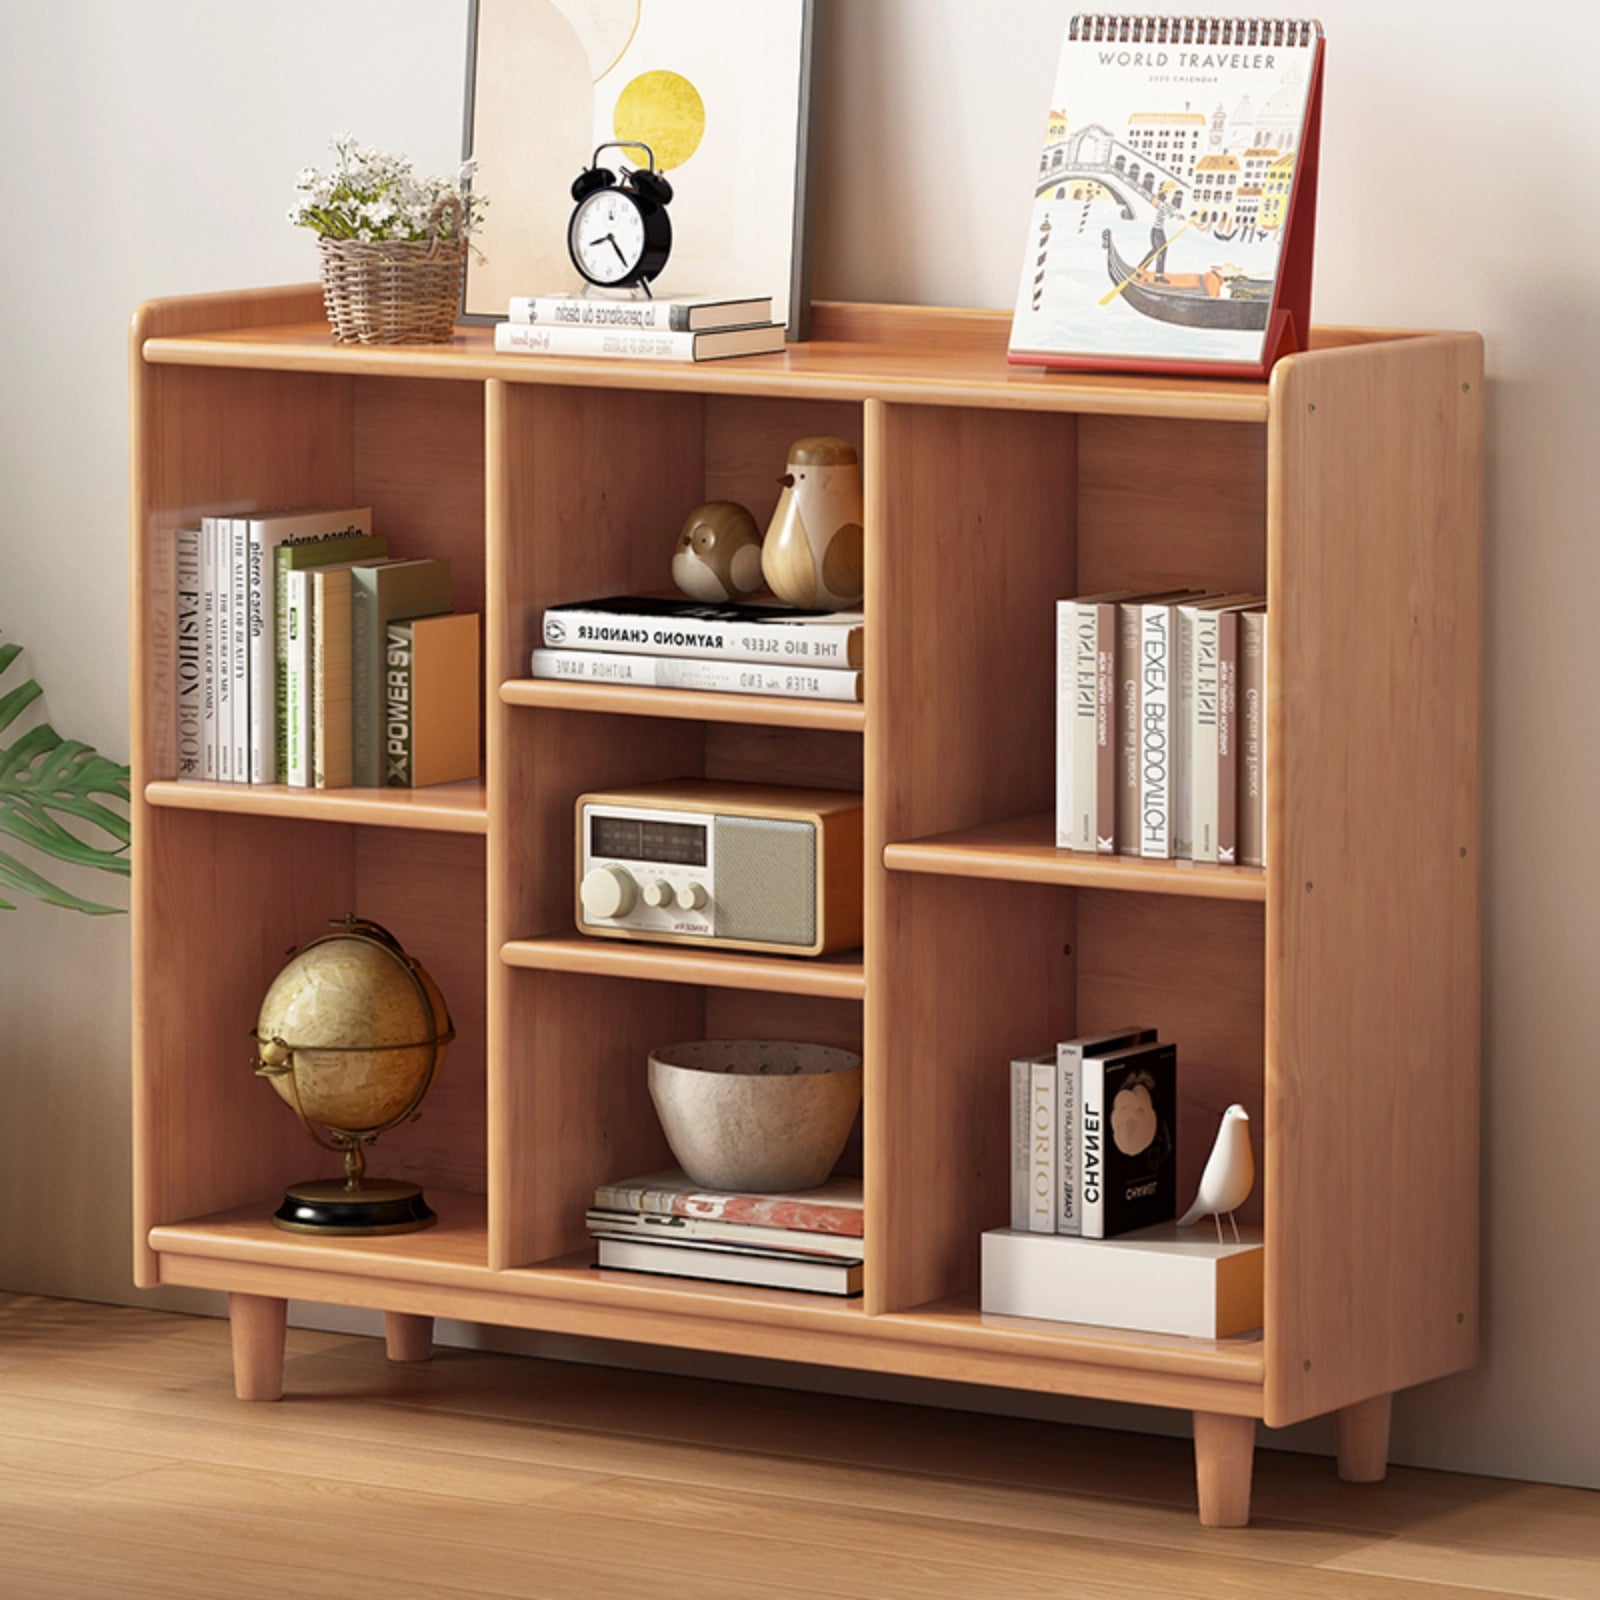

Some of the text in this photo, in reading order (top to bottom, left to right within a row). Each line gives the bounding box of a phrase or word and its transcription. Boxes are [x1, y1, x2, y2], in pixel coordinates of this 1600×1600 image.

[1098, 52, 1276, 69] WORLD TRAVELER
[235, 534, 243, 558] THE
[250, 542, 261, 586] pierre
[220, 593, 228, 613] THE
[251, 590, 264, 637] cardin
[179, 534, 200, 773] THE FASHION BOOK
[205, 591, 214, 720] THE ALLURE OF WOMEN
[221, 678, 229, 702] MEN
[1035, 1084, 1050, 1214] LORIOT
